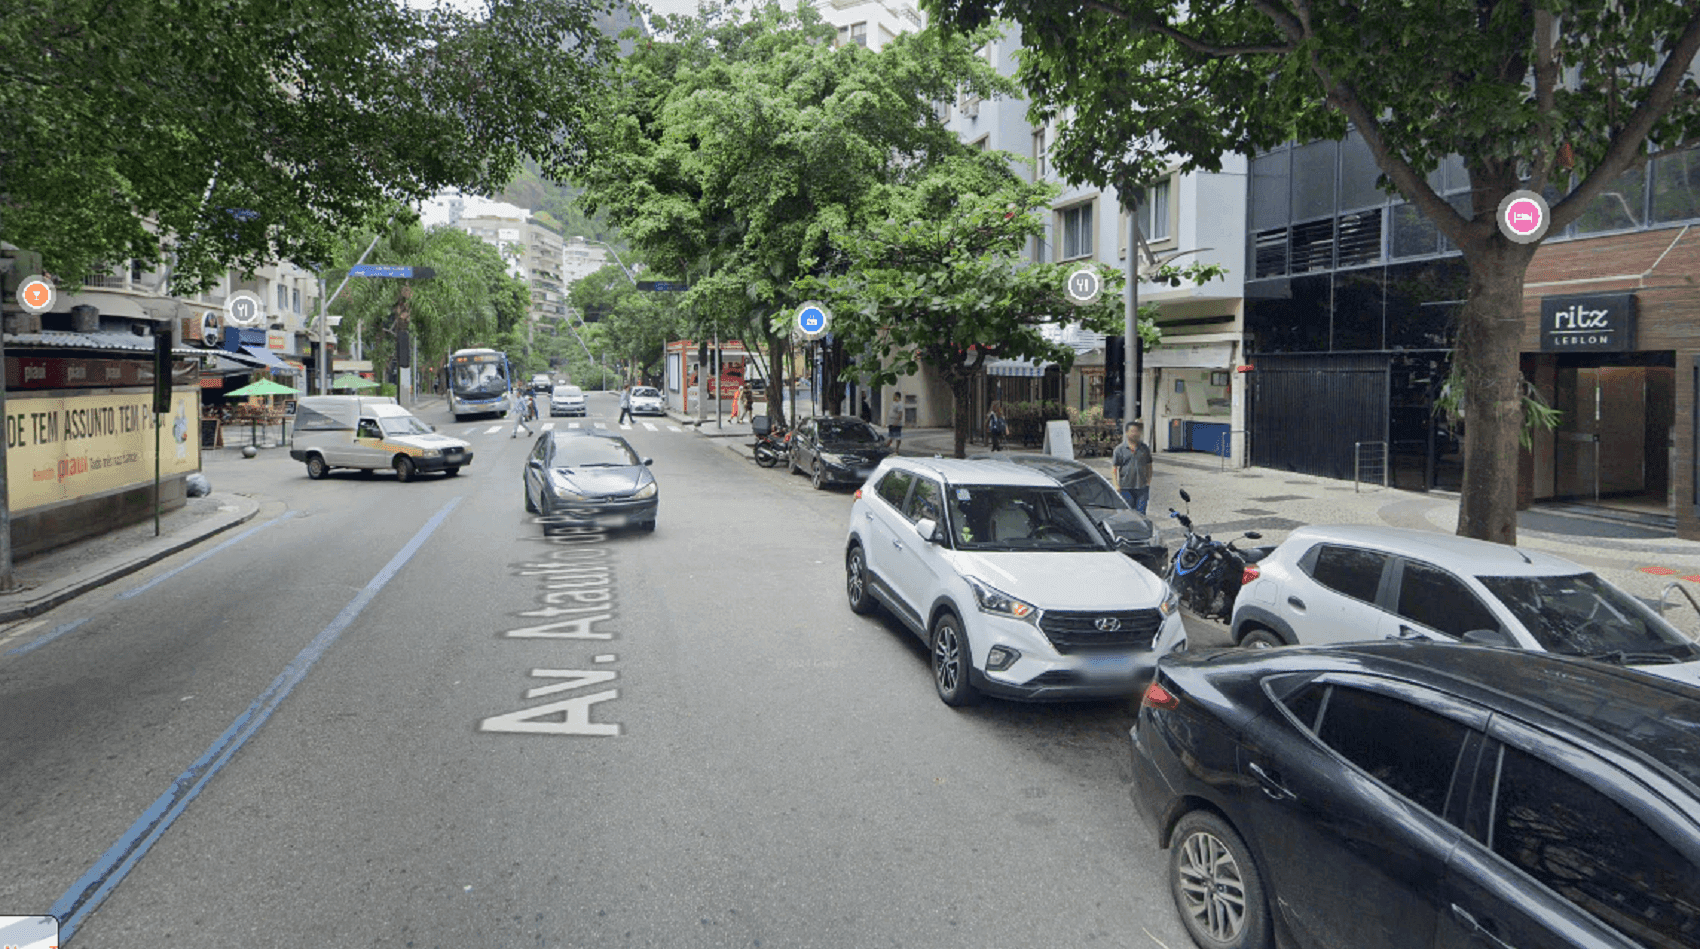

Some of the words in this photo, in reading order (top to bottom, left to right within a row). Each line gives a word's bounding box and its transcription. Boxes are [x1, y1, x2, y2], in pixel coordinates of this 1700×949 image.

[1555, 305, 1608, 329] ritz
[1555, 335, 1608, 346] LEBLON
[31, 411, 59, 445] TEM
[64, 406, 118, 441] ASSUNTO,
[119, 404, 139, 434] TEM
